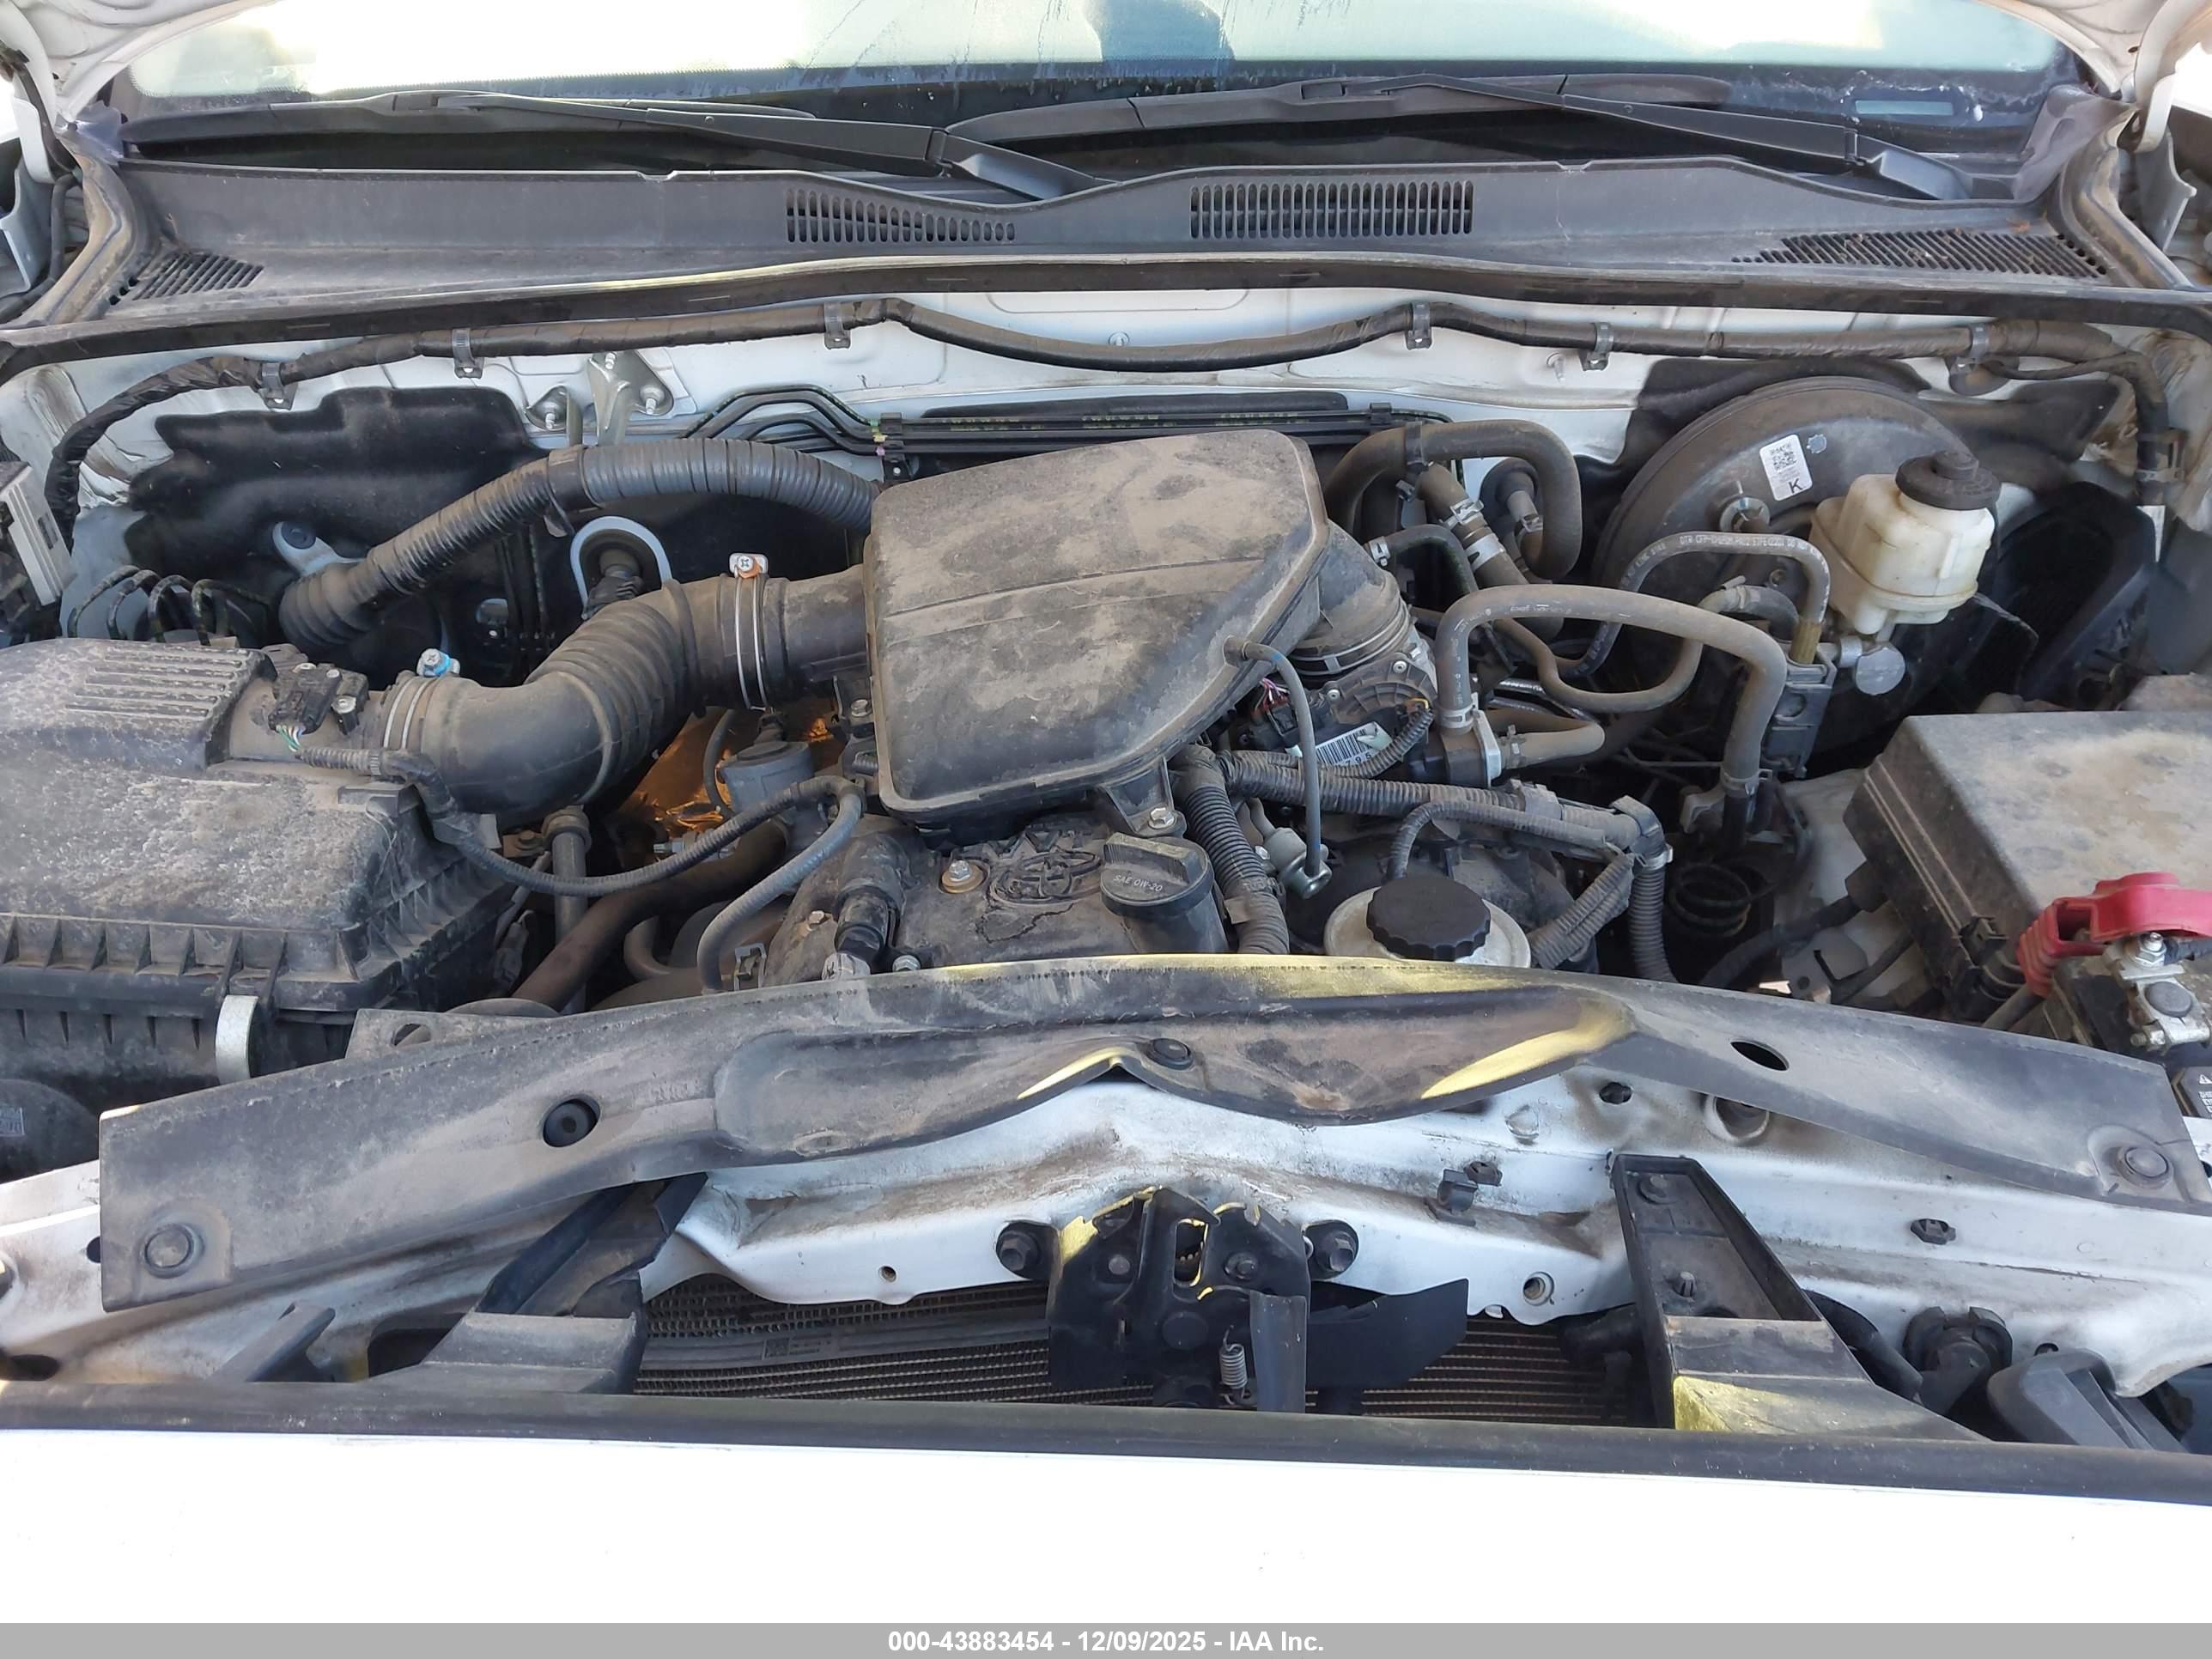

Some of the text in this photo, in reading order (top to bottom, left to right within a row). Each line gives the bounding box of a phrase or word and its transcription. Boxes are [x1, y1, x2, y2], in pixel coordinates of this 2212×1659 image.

[1789, 477, 1803, 494] K
[1114, 874, 1163, 892] SAE 0W-20
